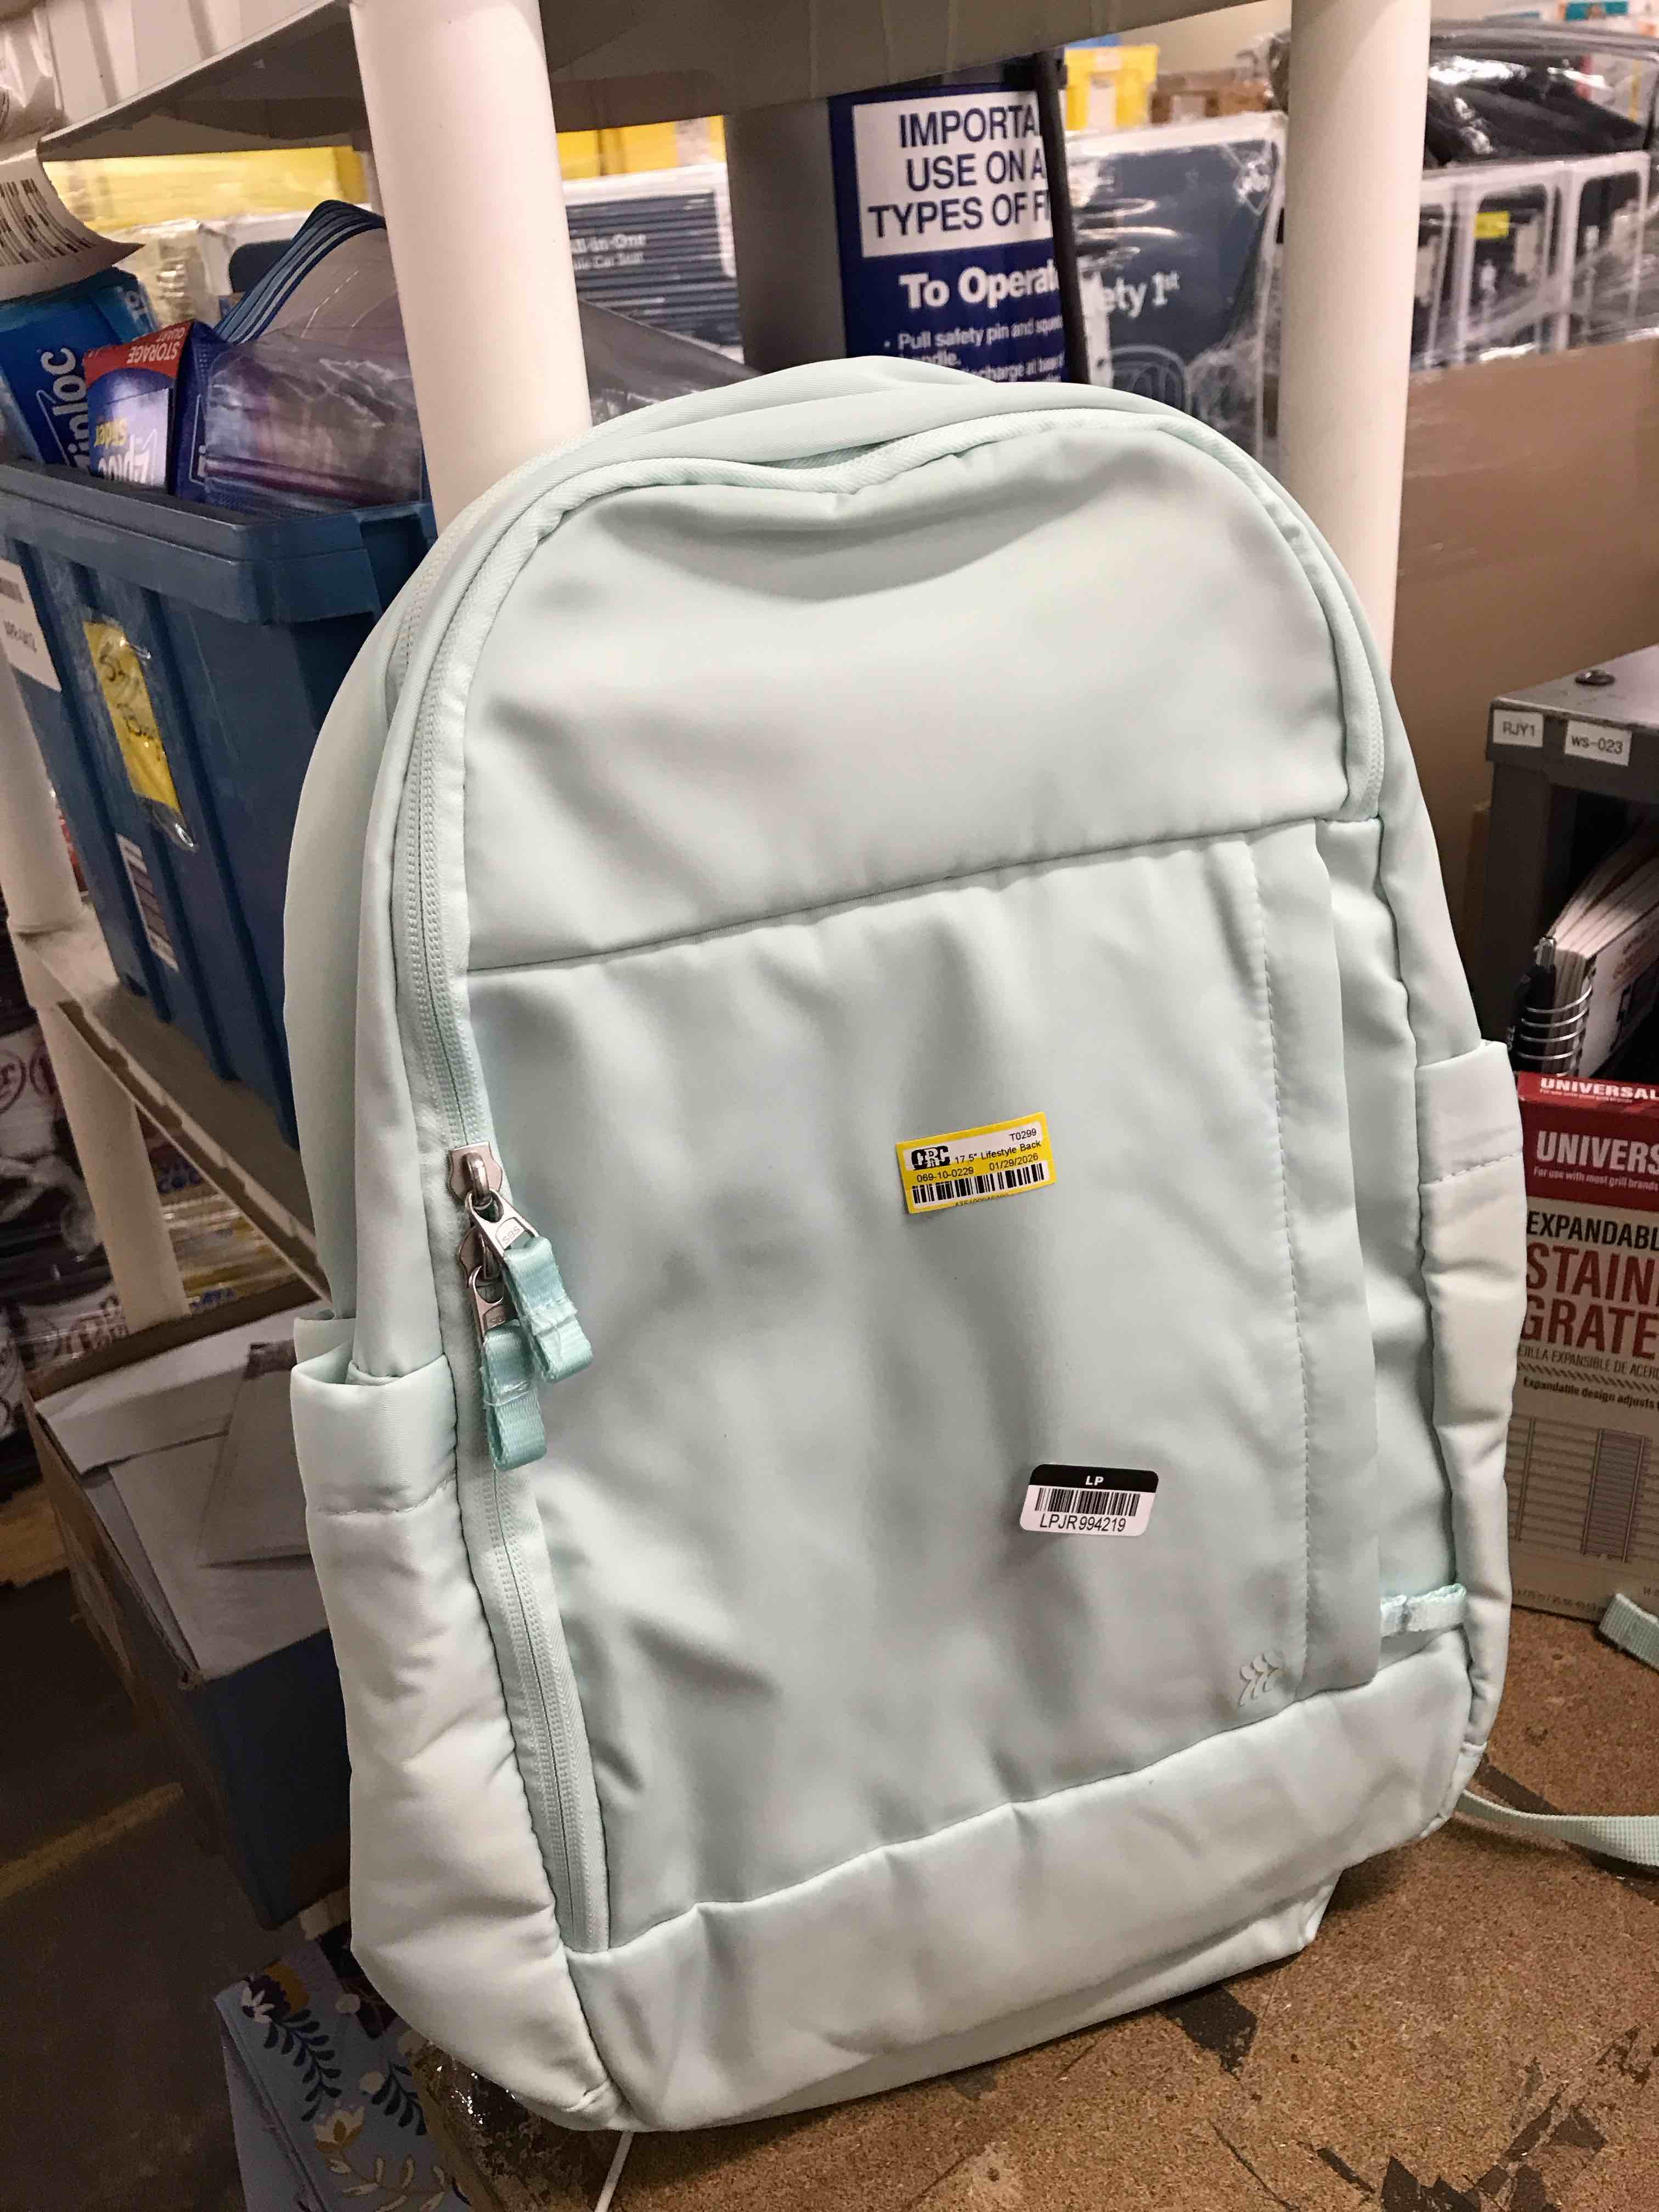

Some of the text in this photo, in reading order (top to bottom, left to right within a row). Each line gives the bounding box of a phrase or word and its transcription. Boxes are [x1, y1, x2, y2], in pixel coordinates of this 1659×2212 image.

[906, 153, 977, 191] USE
[986, 149, 1025, 184] ON
[868, 195, 983, 238] TYPES
[992, 191, 1028, 227] OF
[898, 272, 950, 309] To
[898, 330, 931, 350] Pull
[934, 326, 984, 347] safety
[987, 322, 1009, 346] pin
[1011, 317, 1034, 338] and
[126, 341, 180, 364] STORAGE
[1502, 720, 1536, 737] RJY1
[1541, 1077, 1659, 1101] UNIVERSAL
[1009, 1127, 1037, 1142] T0299
[981, 1147, 1017, 1160] Lifestyle
[1020, 1139, 1041, 1152] Back
[1536, 1129, 1659, 1176] UNIVERS
[917, 1153, 1039, 1183] 069-10-0229 01/29/2026
[1533, 1165, 1659, 1193] For use with most grill brands
[1526, 1210, 1659, 1251] EXPANDABL
[1526, 1241, 1659, 1307] STAIN
[1551, 1349, 1610, 1372] EXPANSIBLE
[1613, 1359, 1629, 1374] DE
[1522, 1376, 1580, 1396] Expandable
[1582, 1386, 1616, 1403] design
[1617, 1393, 1655, 1410] adjusts
[1085, 1475, 1104, 1486] LP
[1040, 1513, 1127, 1532] LPJR994219
